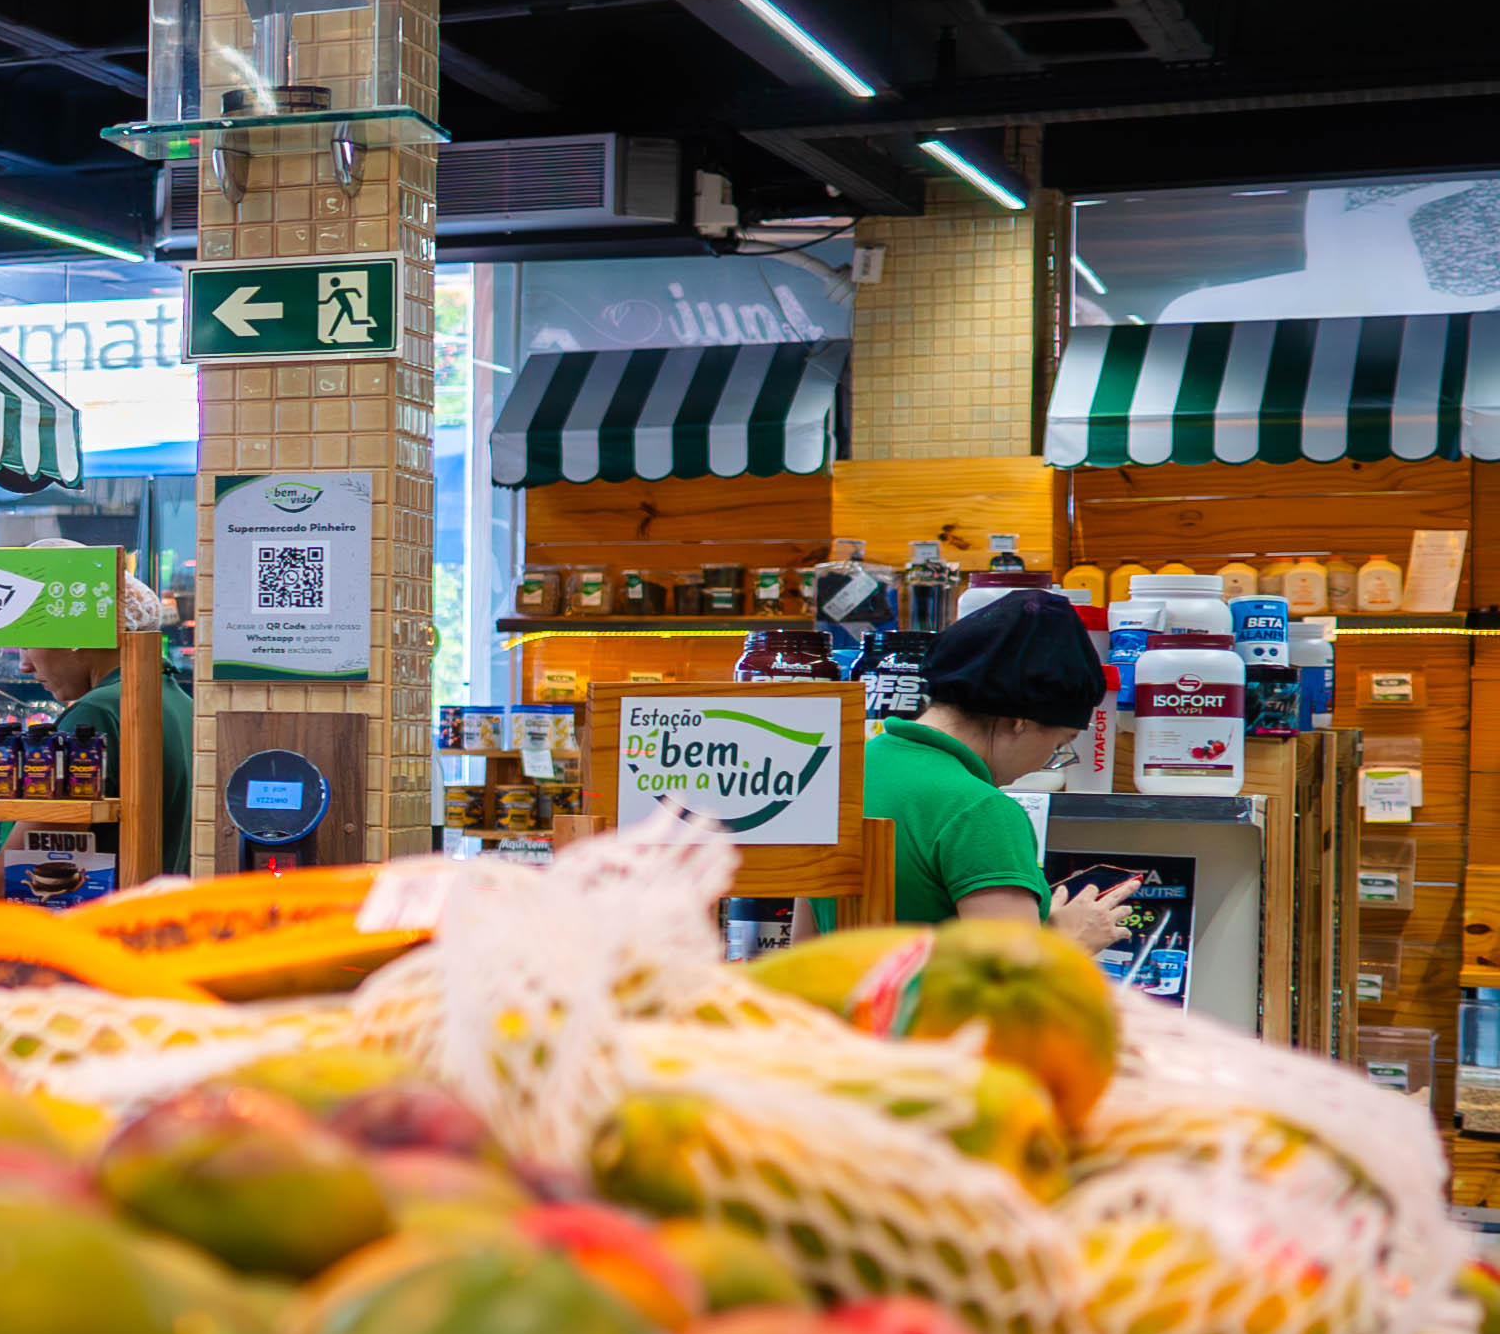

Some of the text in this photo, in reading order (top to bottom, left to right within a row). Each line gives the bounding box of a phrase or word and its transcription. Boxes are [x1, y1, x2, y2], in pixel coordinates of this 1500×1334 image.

[227, 522, 356, 533] Supermercado Pinheiro
[266, 622, 281, 631] QR
[1247, 617, 1283, 628] BETA
[246, 634, 294, 643] Whatsapp
[252, 646, 286, 654] ofertas
[860, 674, 928, 693] BES
[1152, 693, 1226, 708] ISOFORT
[630, 707, 702, 733] Estação
[625, 728, 739, 768] Dé bem
[1093, 709, 1107, 772] VITAFOR
[637, 756, 794, 797] com a vida
[28, 832, 89, 852] BENDU
